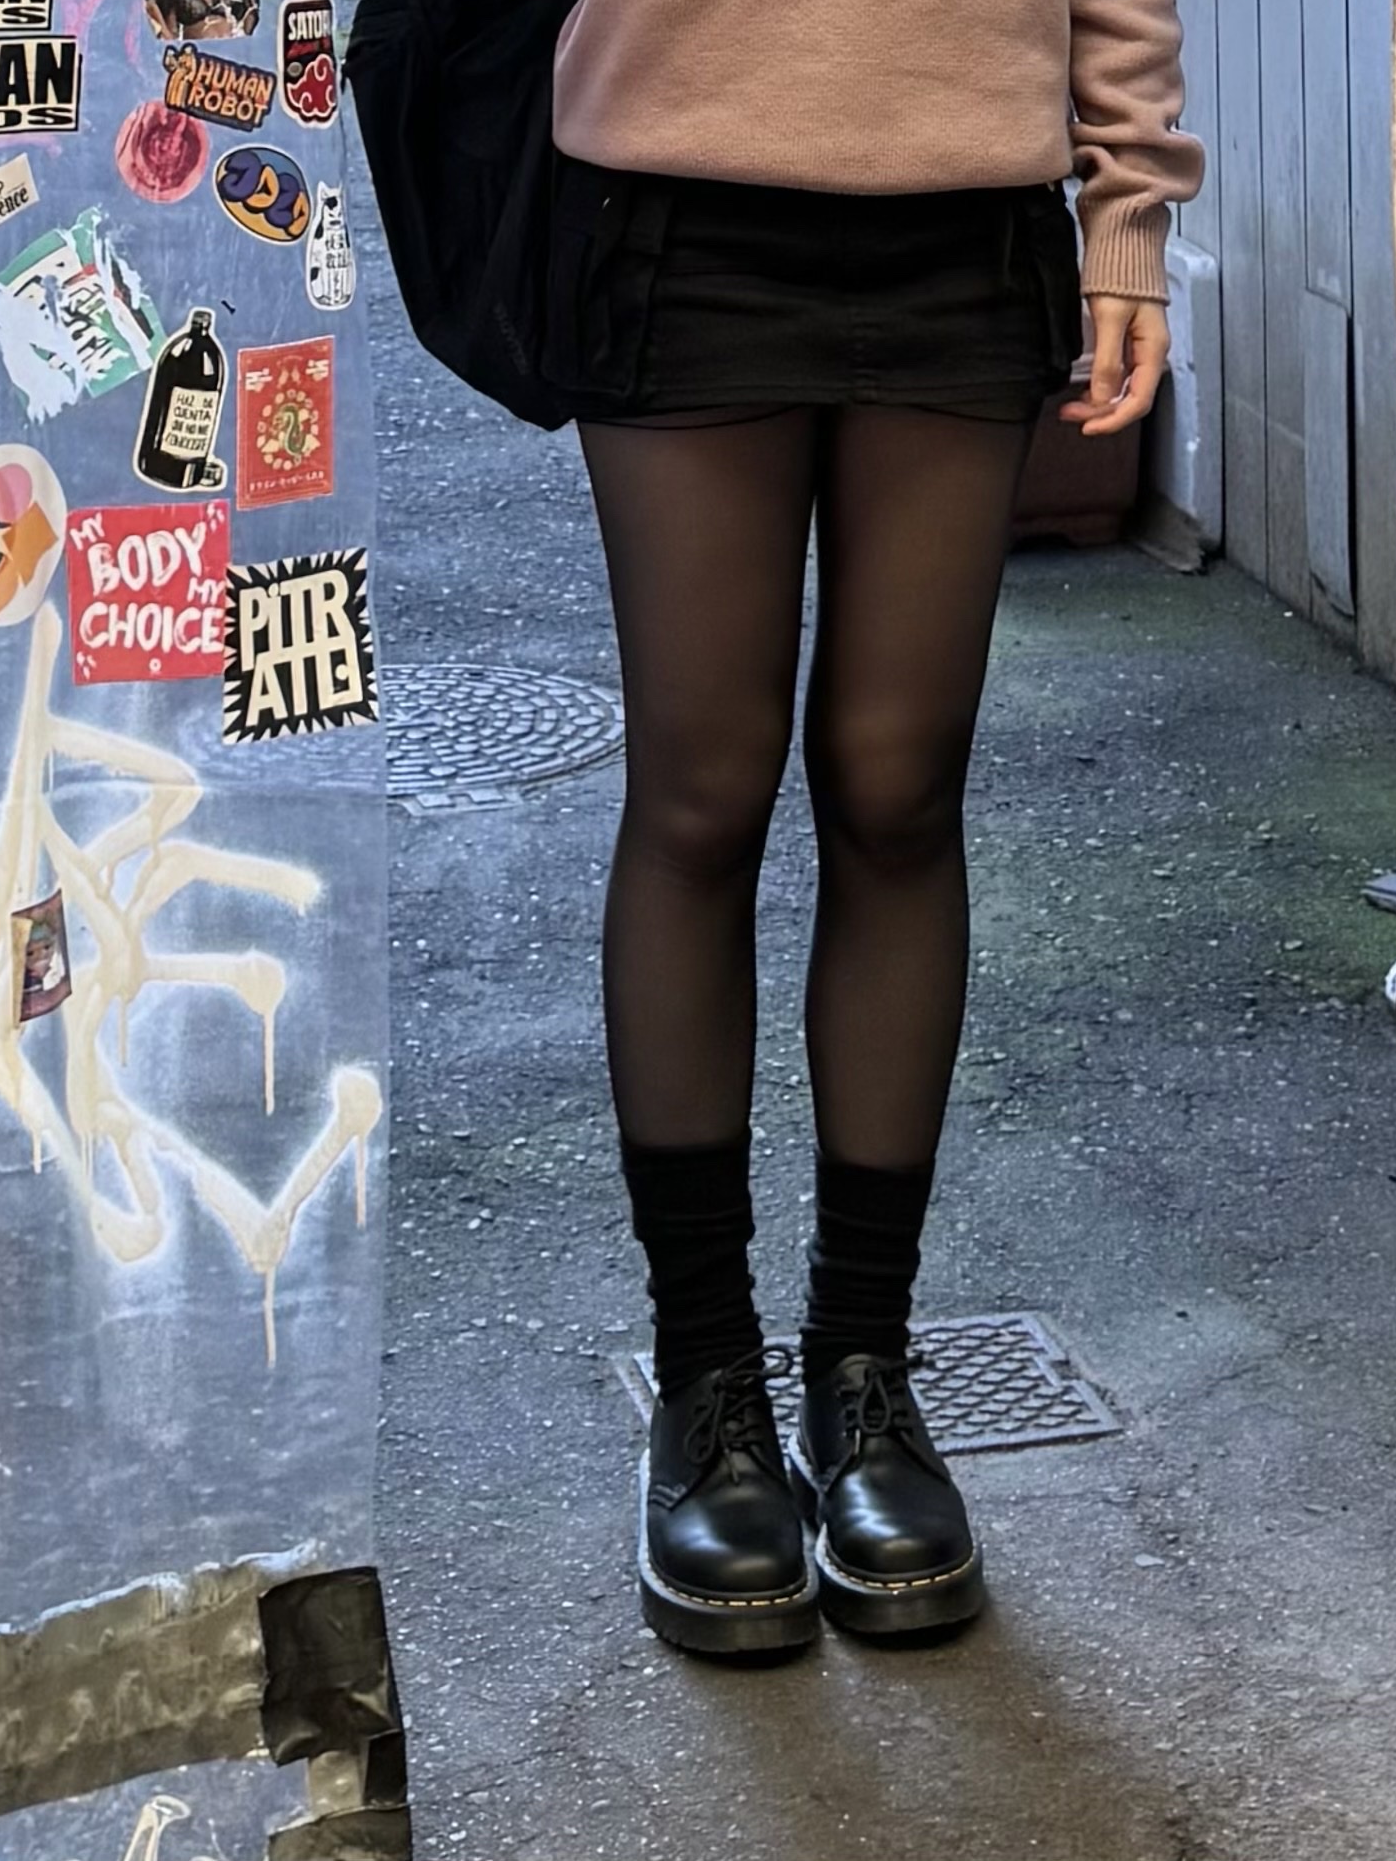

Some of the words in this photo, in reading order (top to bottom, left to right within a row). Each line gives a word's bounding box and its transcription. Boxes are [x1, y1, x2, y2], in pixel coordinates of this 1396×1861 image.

[195, 59, 274, 100] HUMAN
[187, 83, 269, 125] ROBOT
[173, 406, 212, 421] CUENTA
[68, 512, 106, 549] MY
[86, 526, 208, 597] BODY
[187, 578, 225, 605] MY
[79, 601, 226, 654] CHOICE
